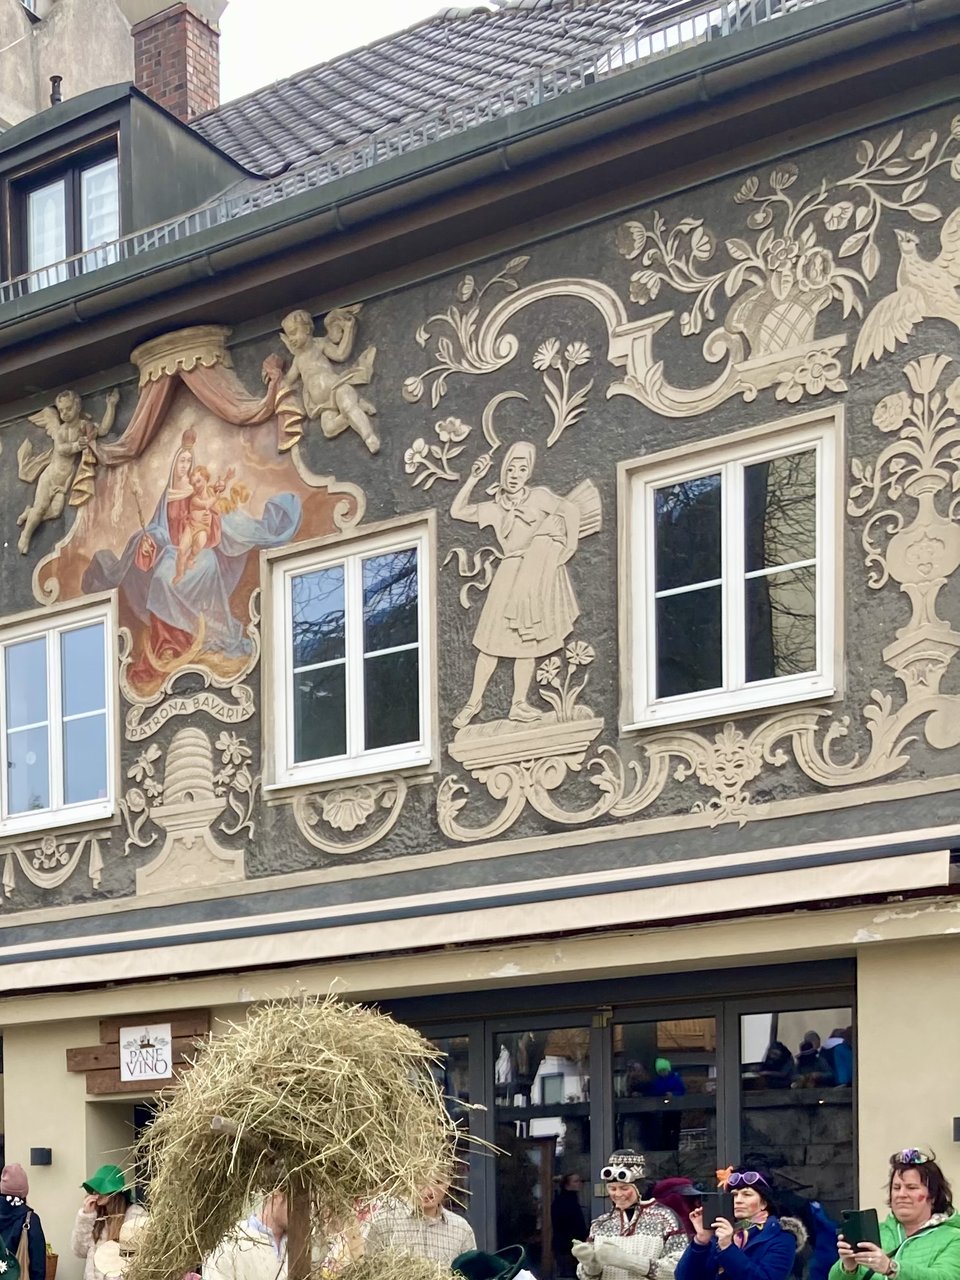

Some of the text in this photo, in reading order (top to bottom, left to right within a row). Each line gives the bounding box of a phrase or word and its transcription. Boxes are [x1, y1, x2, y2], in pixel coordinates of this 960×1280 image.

[130, 696, 250, 739] PATRONA BAVARIA
[130, 1048, 162, 1064] PANE
[126, 1059, 167, 1076] VINO
